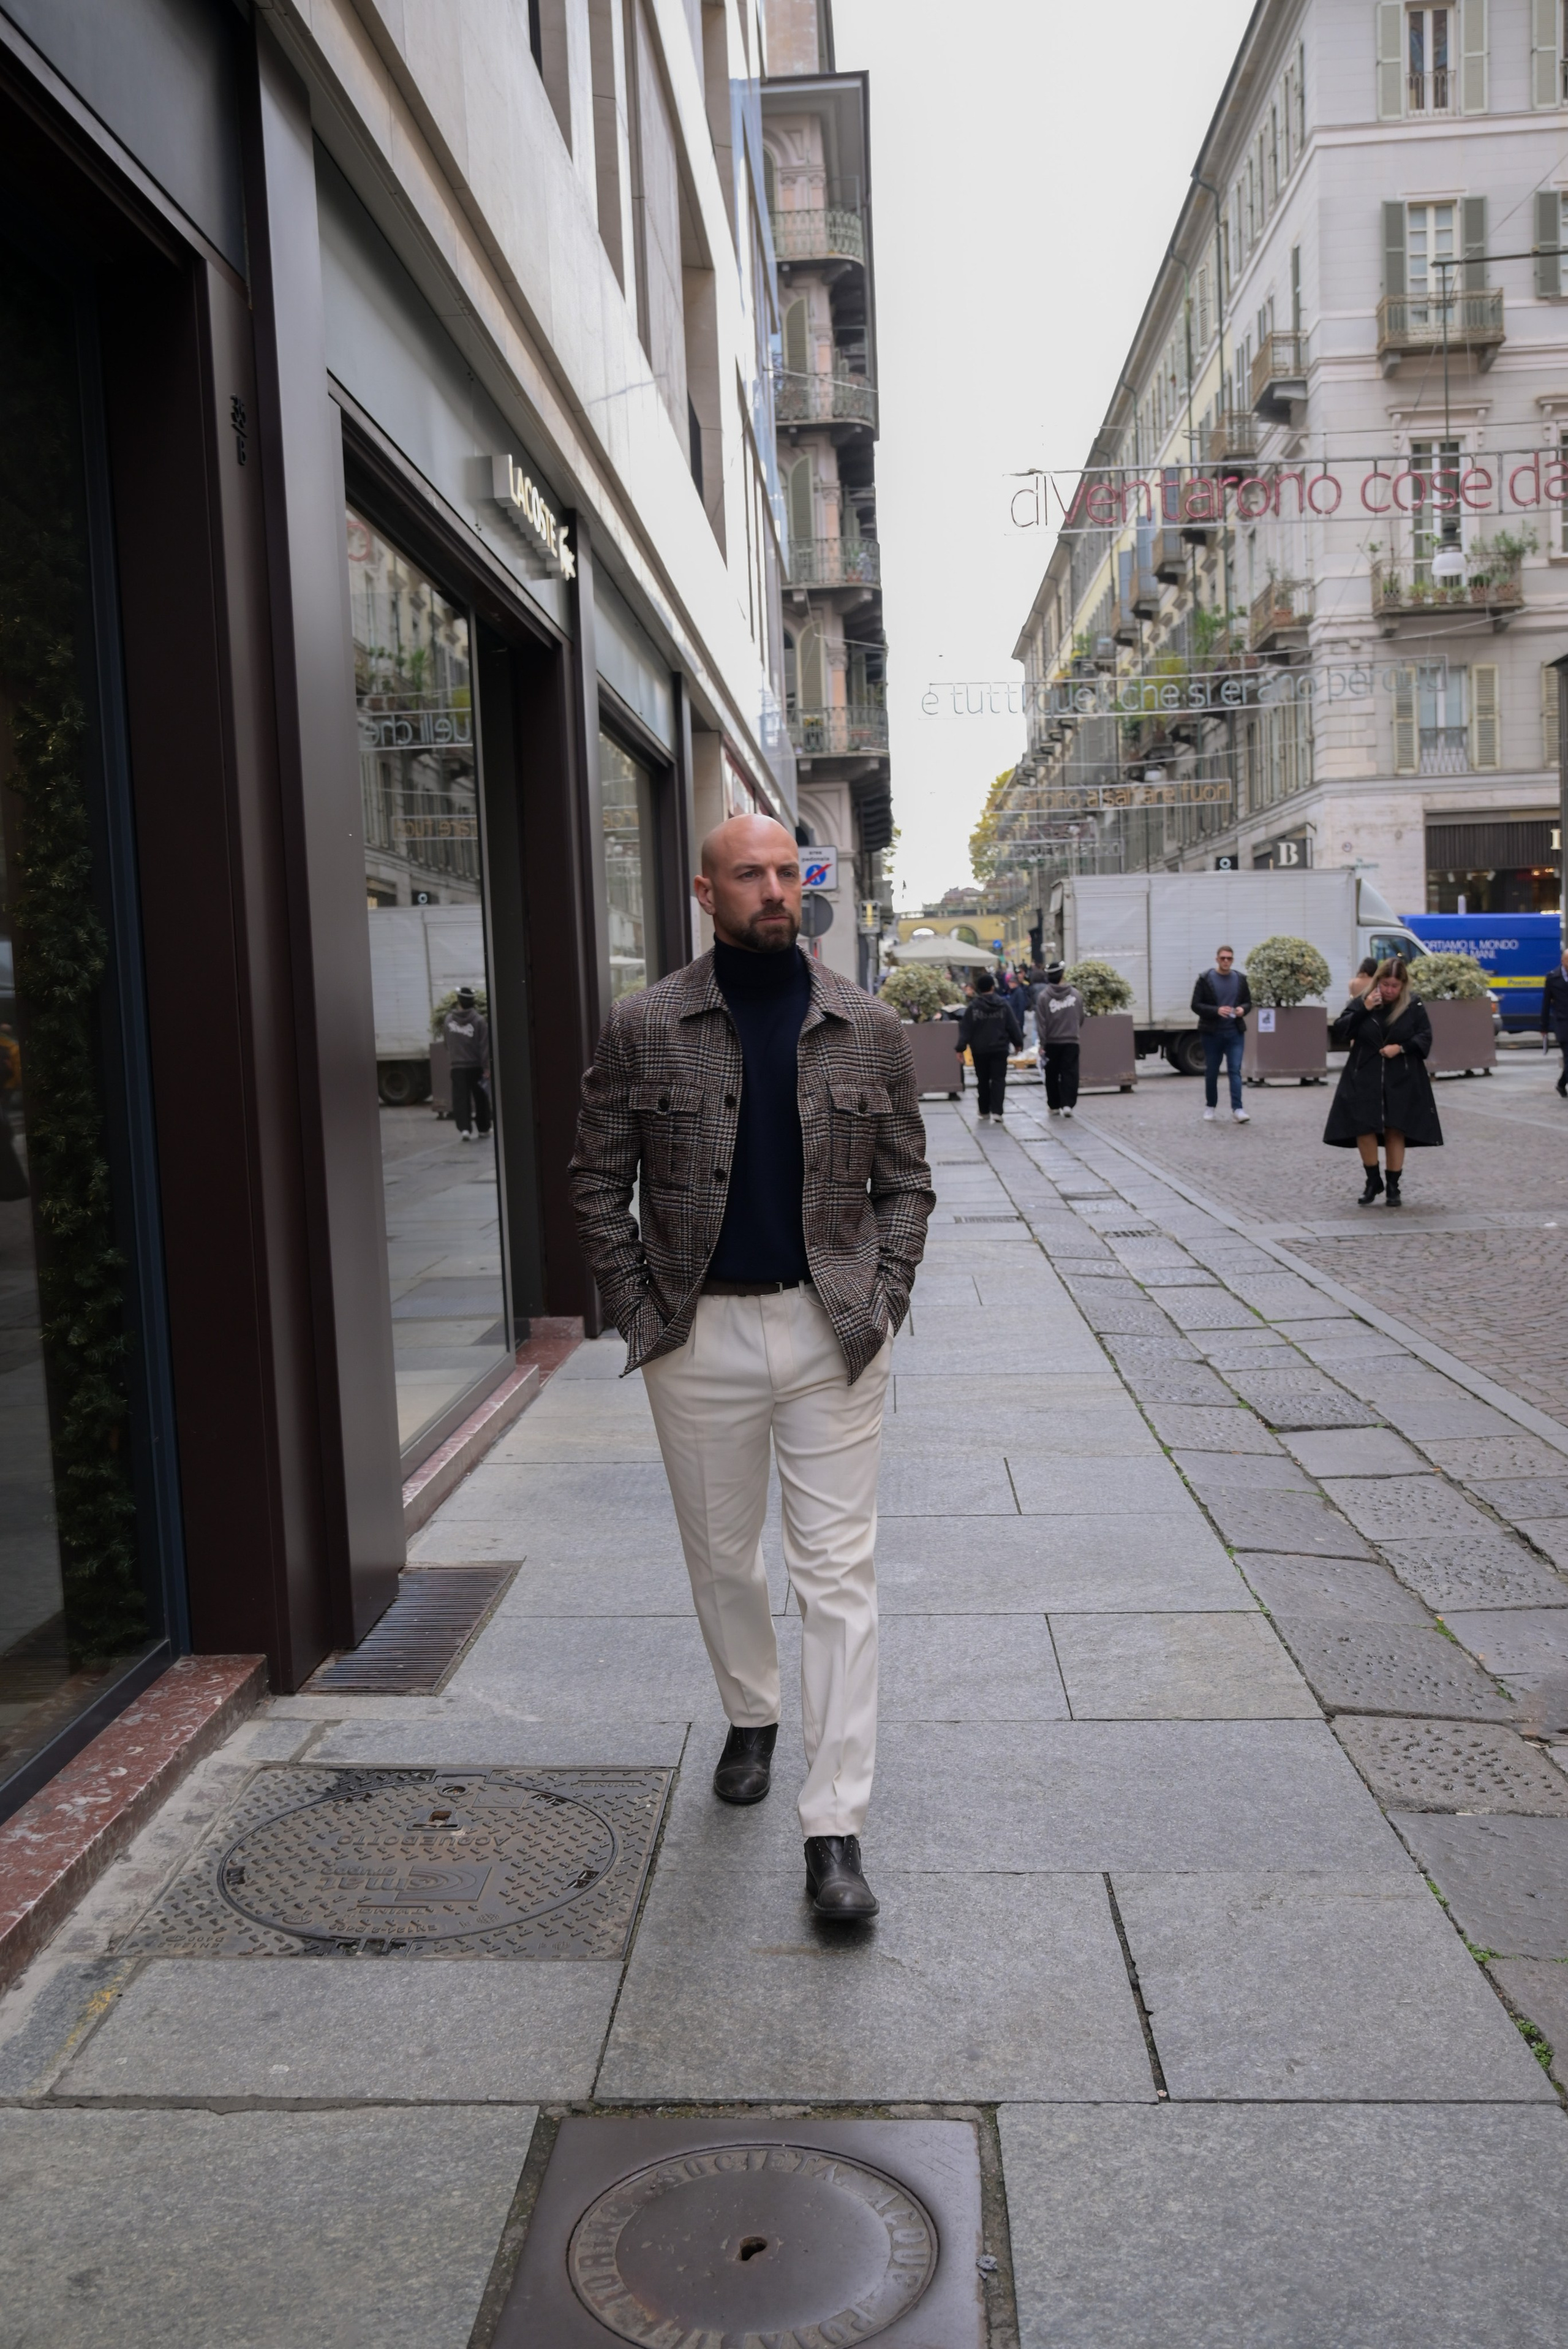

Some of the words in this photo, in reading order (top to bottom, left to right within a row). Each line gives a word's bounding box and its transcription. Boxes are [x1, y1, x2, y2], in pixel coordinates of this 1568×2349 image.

[508, 453, 557, 559] LACOSTE
[1011, 469, 1343, 528] diventarono
[1360, 466, 1493, 513] cose
[921, 691, 940, 716] e
[949, 682, 1027, 716] tutti
[1120, 676, 1182, 711] che
[1188, 679, 1213, 709] si
[1220, 673, 1317, 706] erano
[1180, 780, 1231, 803] fuori
[1277, 841, 1299, 866] B
[1423, 939, 1468, 950] ORTIAMO
[1479, 939, 1519, 950] MONDO
